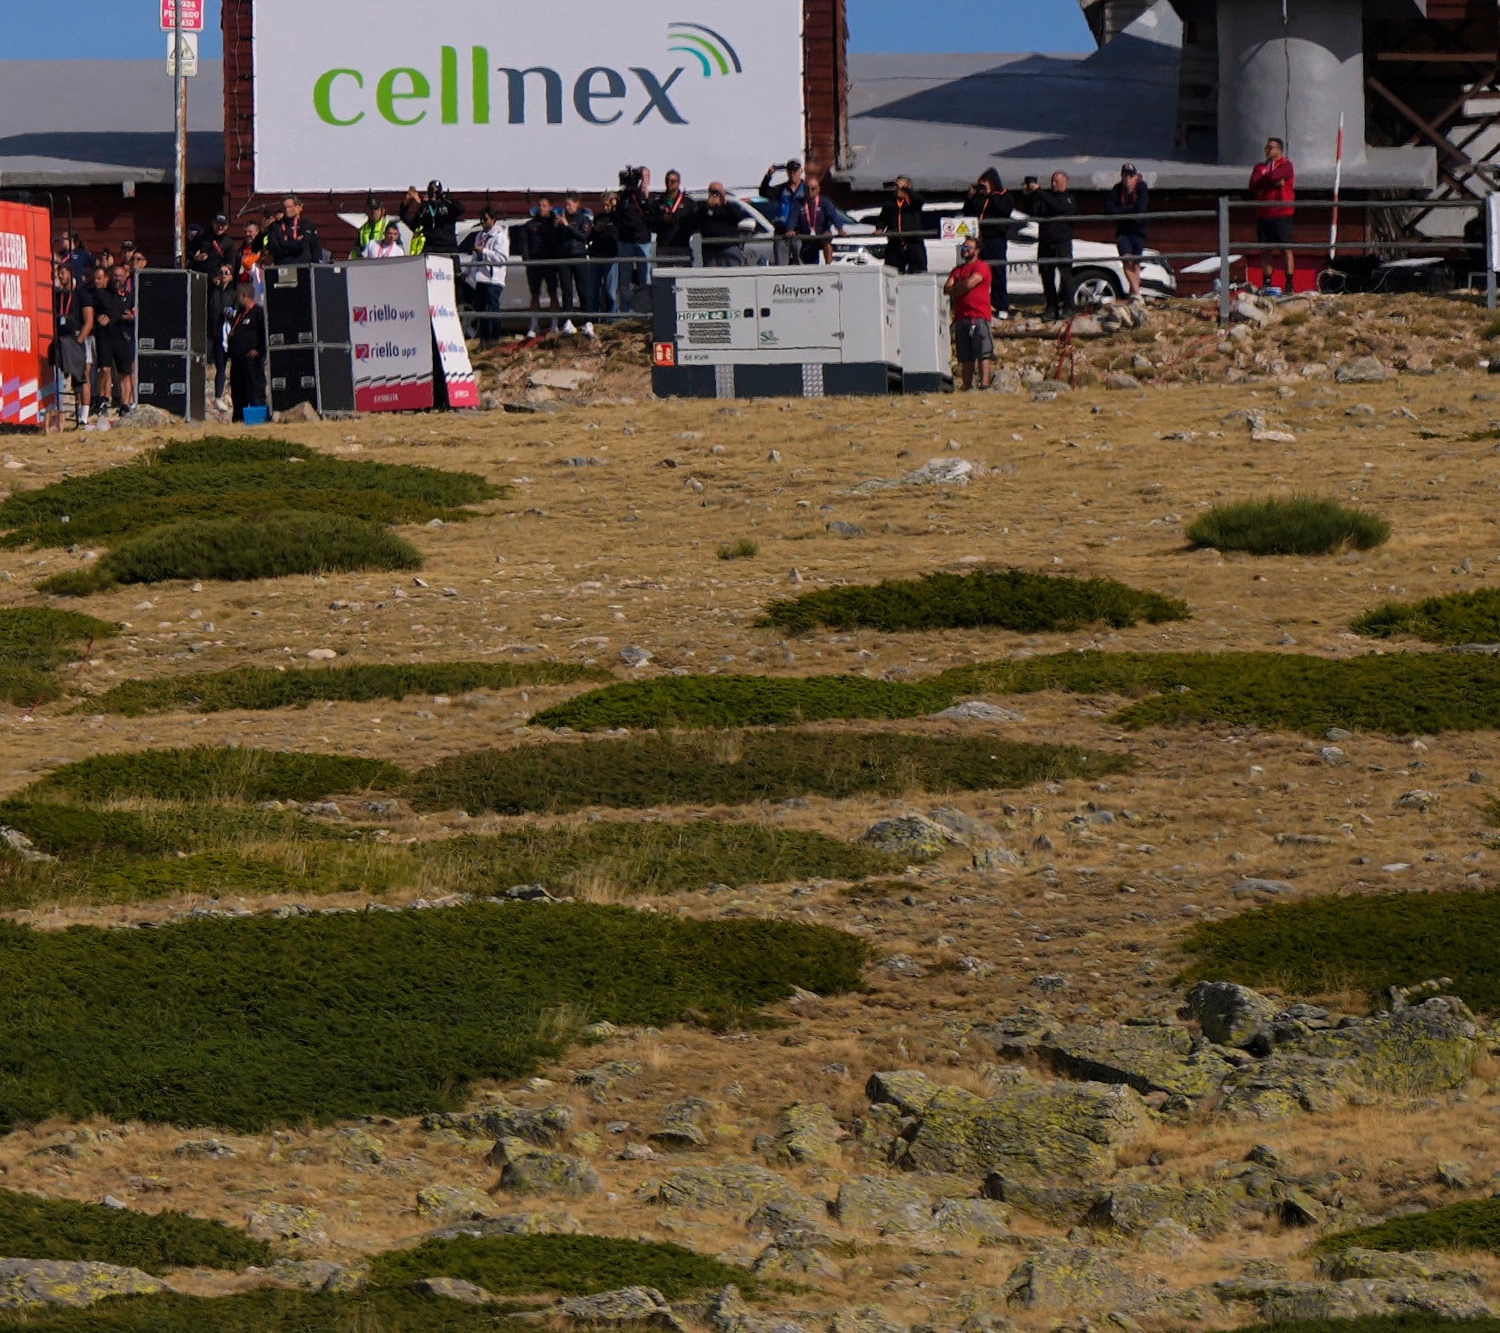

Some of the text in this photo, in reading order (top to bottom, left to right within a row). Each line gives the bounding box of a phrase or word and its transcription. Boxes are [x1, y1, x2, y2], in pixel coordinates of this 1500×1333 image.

[312, 45, 690, 126] cellnex
[0, 272, 23, 311] CADA
[773, 283, 815, 298] Alayan
[368, 303, 415, 322] riello ups
[370, 341, 418, 359] riello ups
